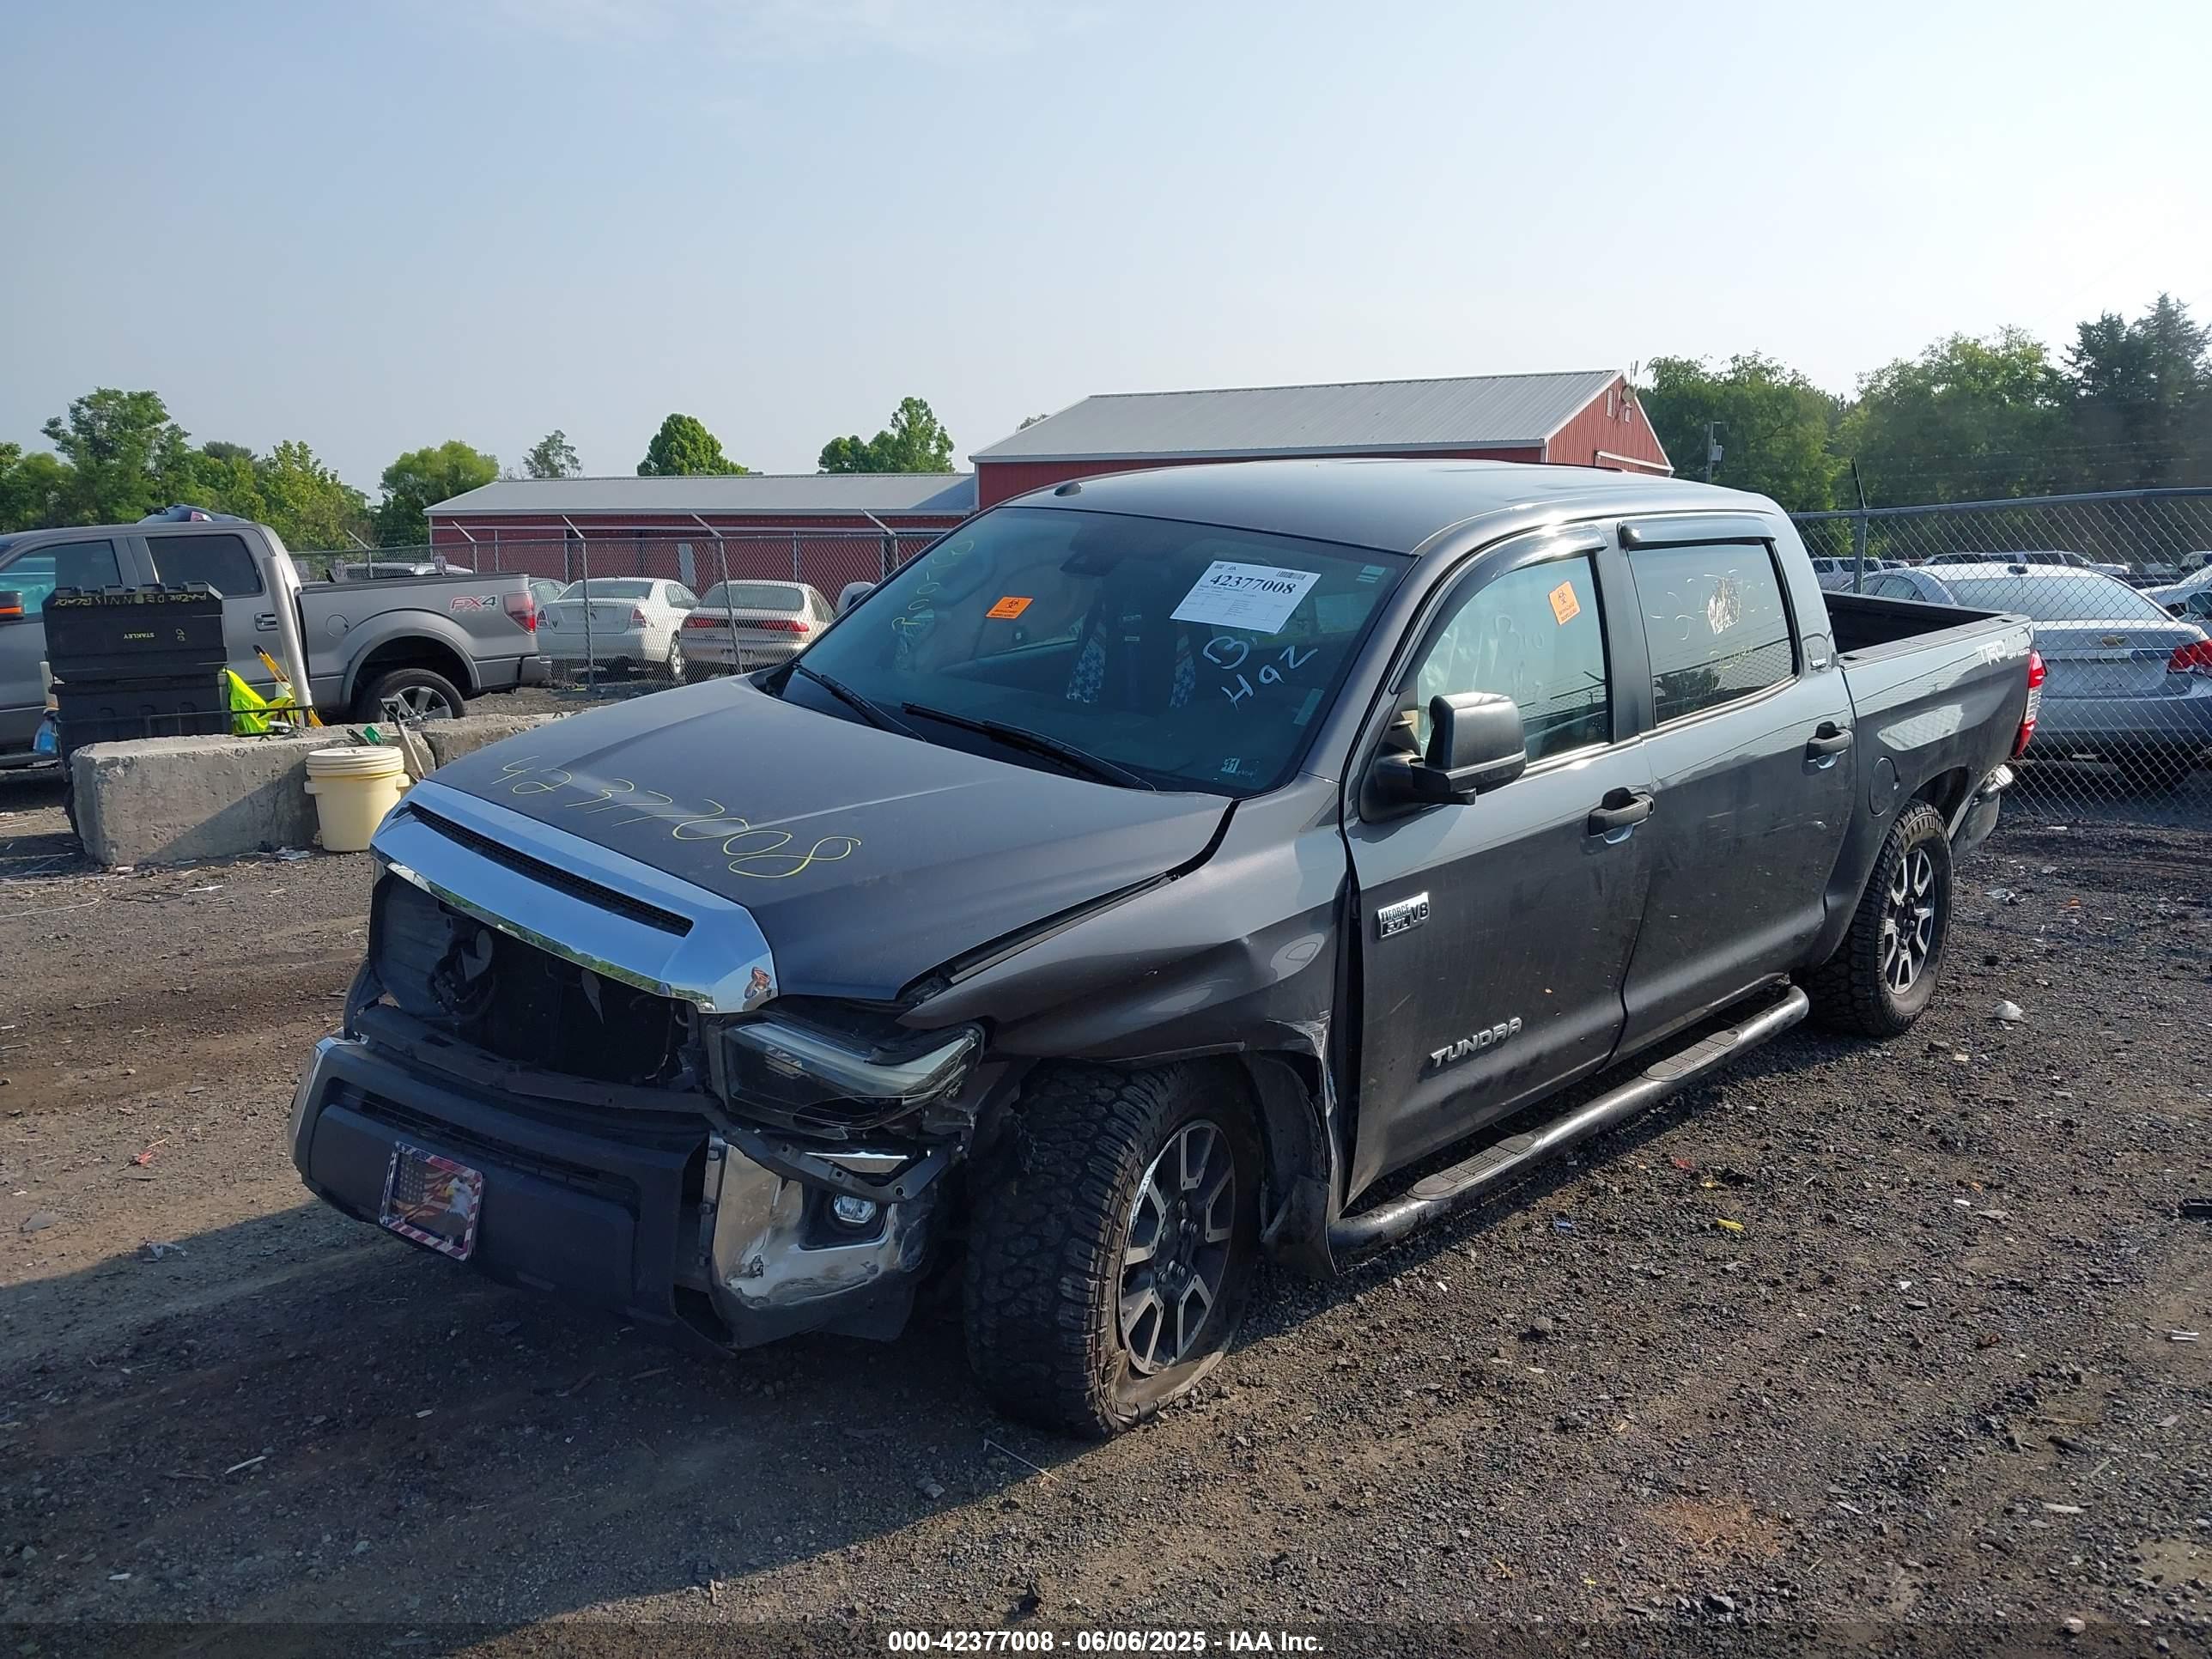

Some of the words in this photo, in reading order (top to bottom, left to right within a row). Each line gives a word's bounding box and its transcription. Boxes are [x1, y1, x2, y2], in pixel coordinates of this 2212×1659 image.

[1209, 574, 1297, 594] 42377008
[450, 594, 498, 611] FX4
[1976, 640, 2005, 665] TRD
[491, 756, 862, 878] 42377008
[1430, 1017, 1522, 1068] TUNDRA
